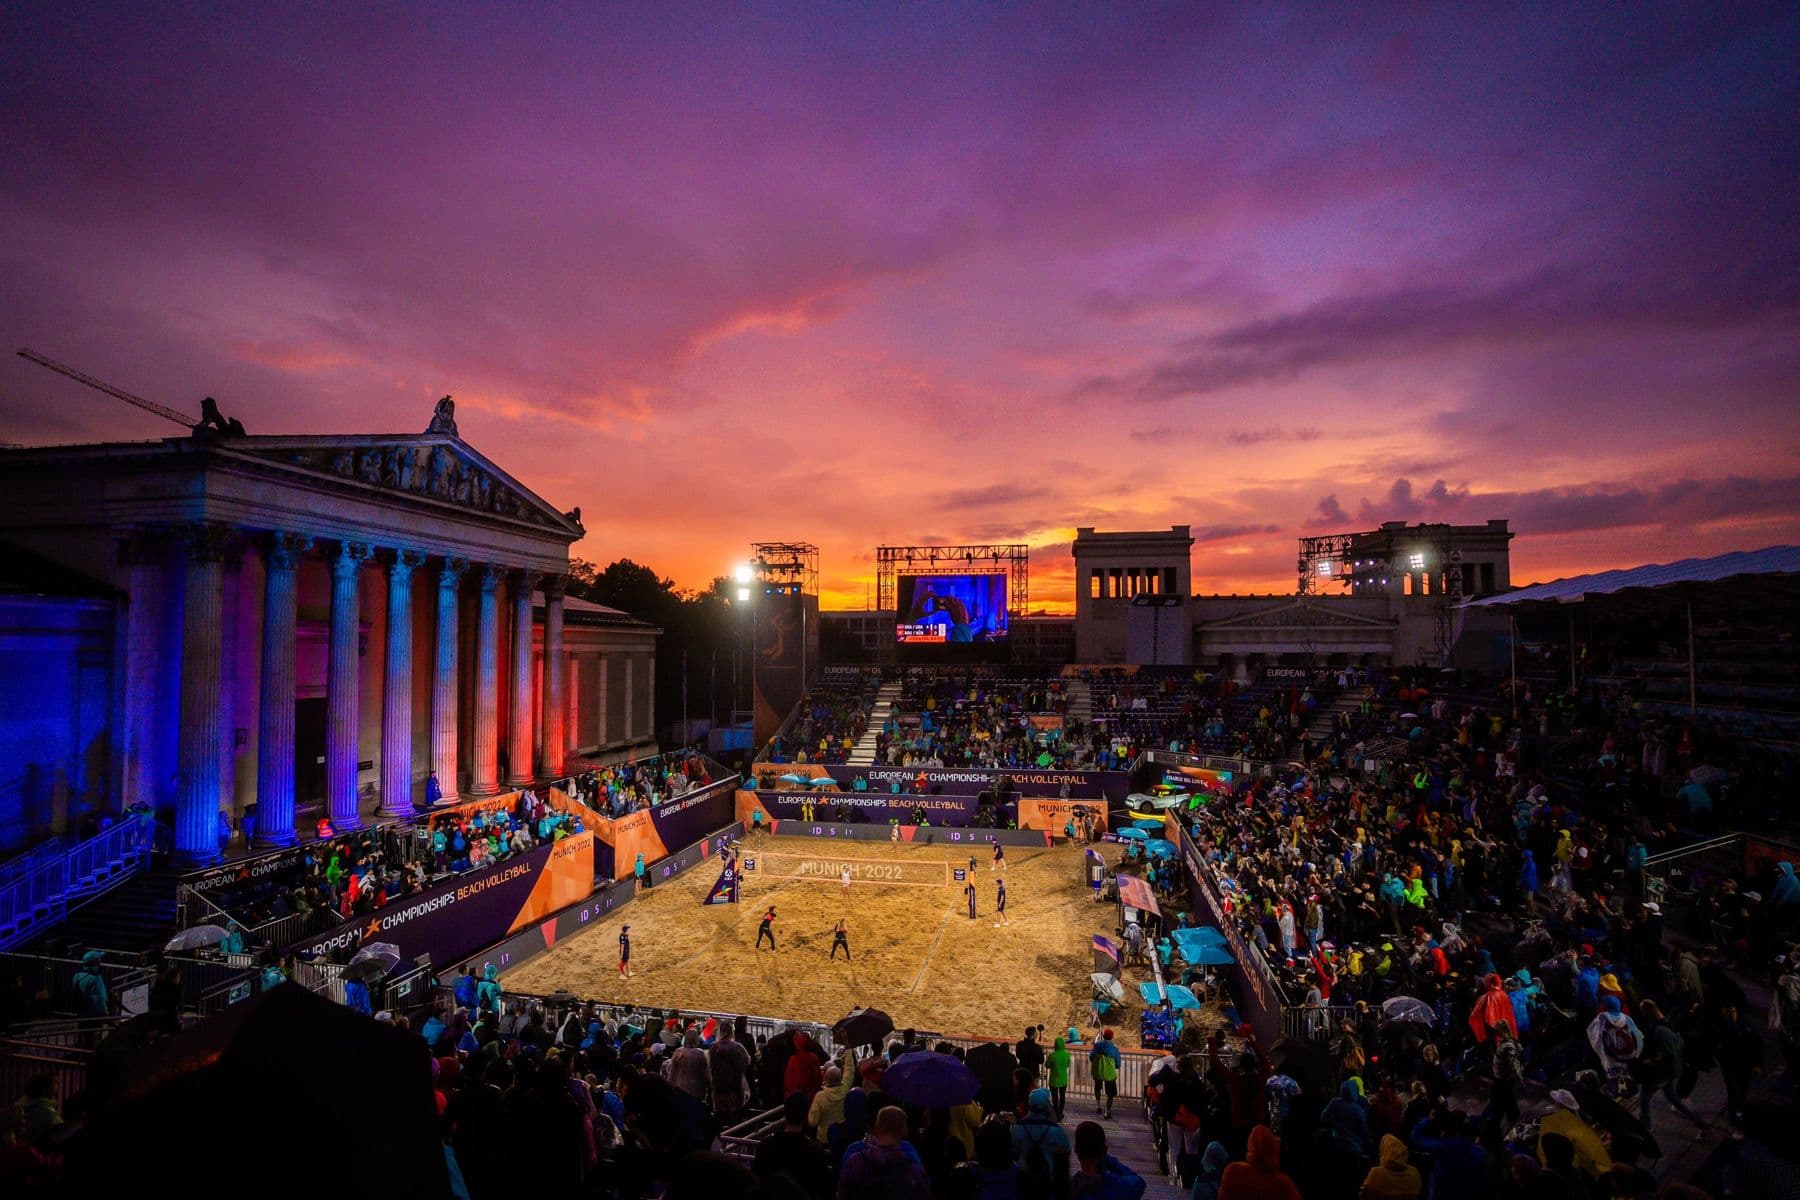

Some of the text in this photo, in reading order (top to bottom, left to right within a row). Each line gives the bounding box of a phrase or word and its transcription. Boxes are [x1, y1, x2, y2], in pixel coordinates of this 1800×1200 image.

[824, 666, 859, 674] EUROPEAN
[1267, 669, 1305, 677] EUROPEAN
[869, 771, 914, 781] EUROPEAN
[1030, 774, 1088, 785] VOLLEYBALL
[778, 796, 966, 810] EUROPEAN CHAMPIONSHIPS BEACH VOLLEYBALL
[553, 839, 591, 860] MUNICH 2022
[800, 861, 903, 880] MUNICH 2022
[382, 892, 455, 930] CHAMPIONSHIPS
[457, 881, 485, 901] BEACH
[486, 862, 532, 889] VOLLEYBALL
